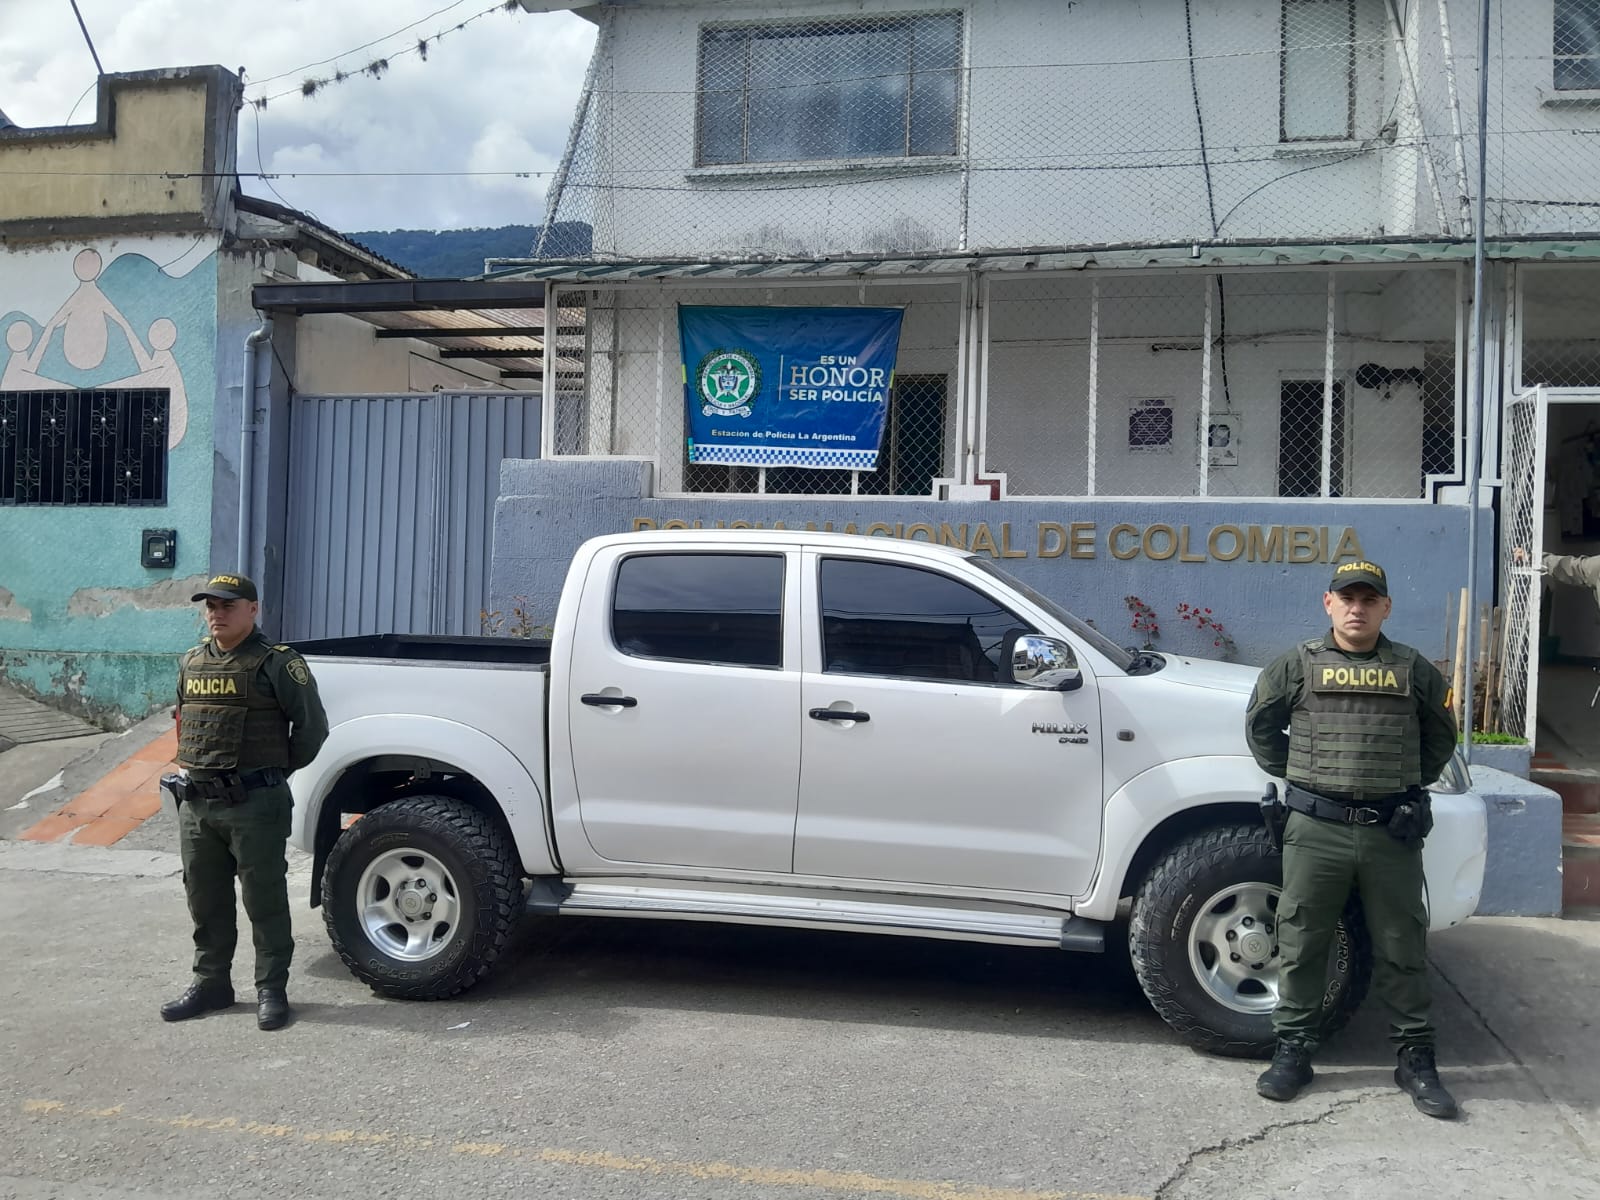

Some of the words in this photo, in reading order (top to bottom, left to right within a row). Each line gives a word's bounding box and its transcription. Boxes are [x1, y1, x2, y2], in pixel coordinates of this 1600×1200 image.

[820, 355, 835, 365] ES
[838, 356, 857, 366] UN
[790, 366, 885, 388] HONOR
[789, 389, 817, 401] SER
[821, 388, 883, 403] POLICÍA
[798, 432, 809, 440] La
[811, 433, 856, 442] Argentina
[1037, 521, 1096, 559] DE
[1107, 523, 1365, 564] COLOMBIA
[1322, 667, 1398, 688] POLICIA
[186, 678, 237, 695] POLICIA
[1031, 722, 1088, 734] HILUX
